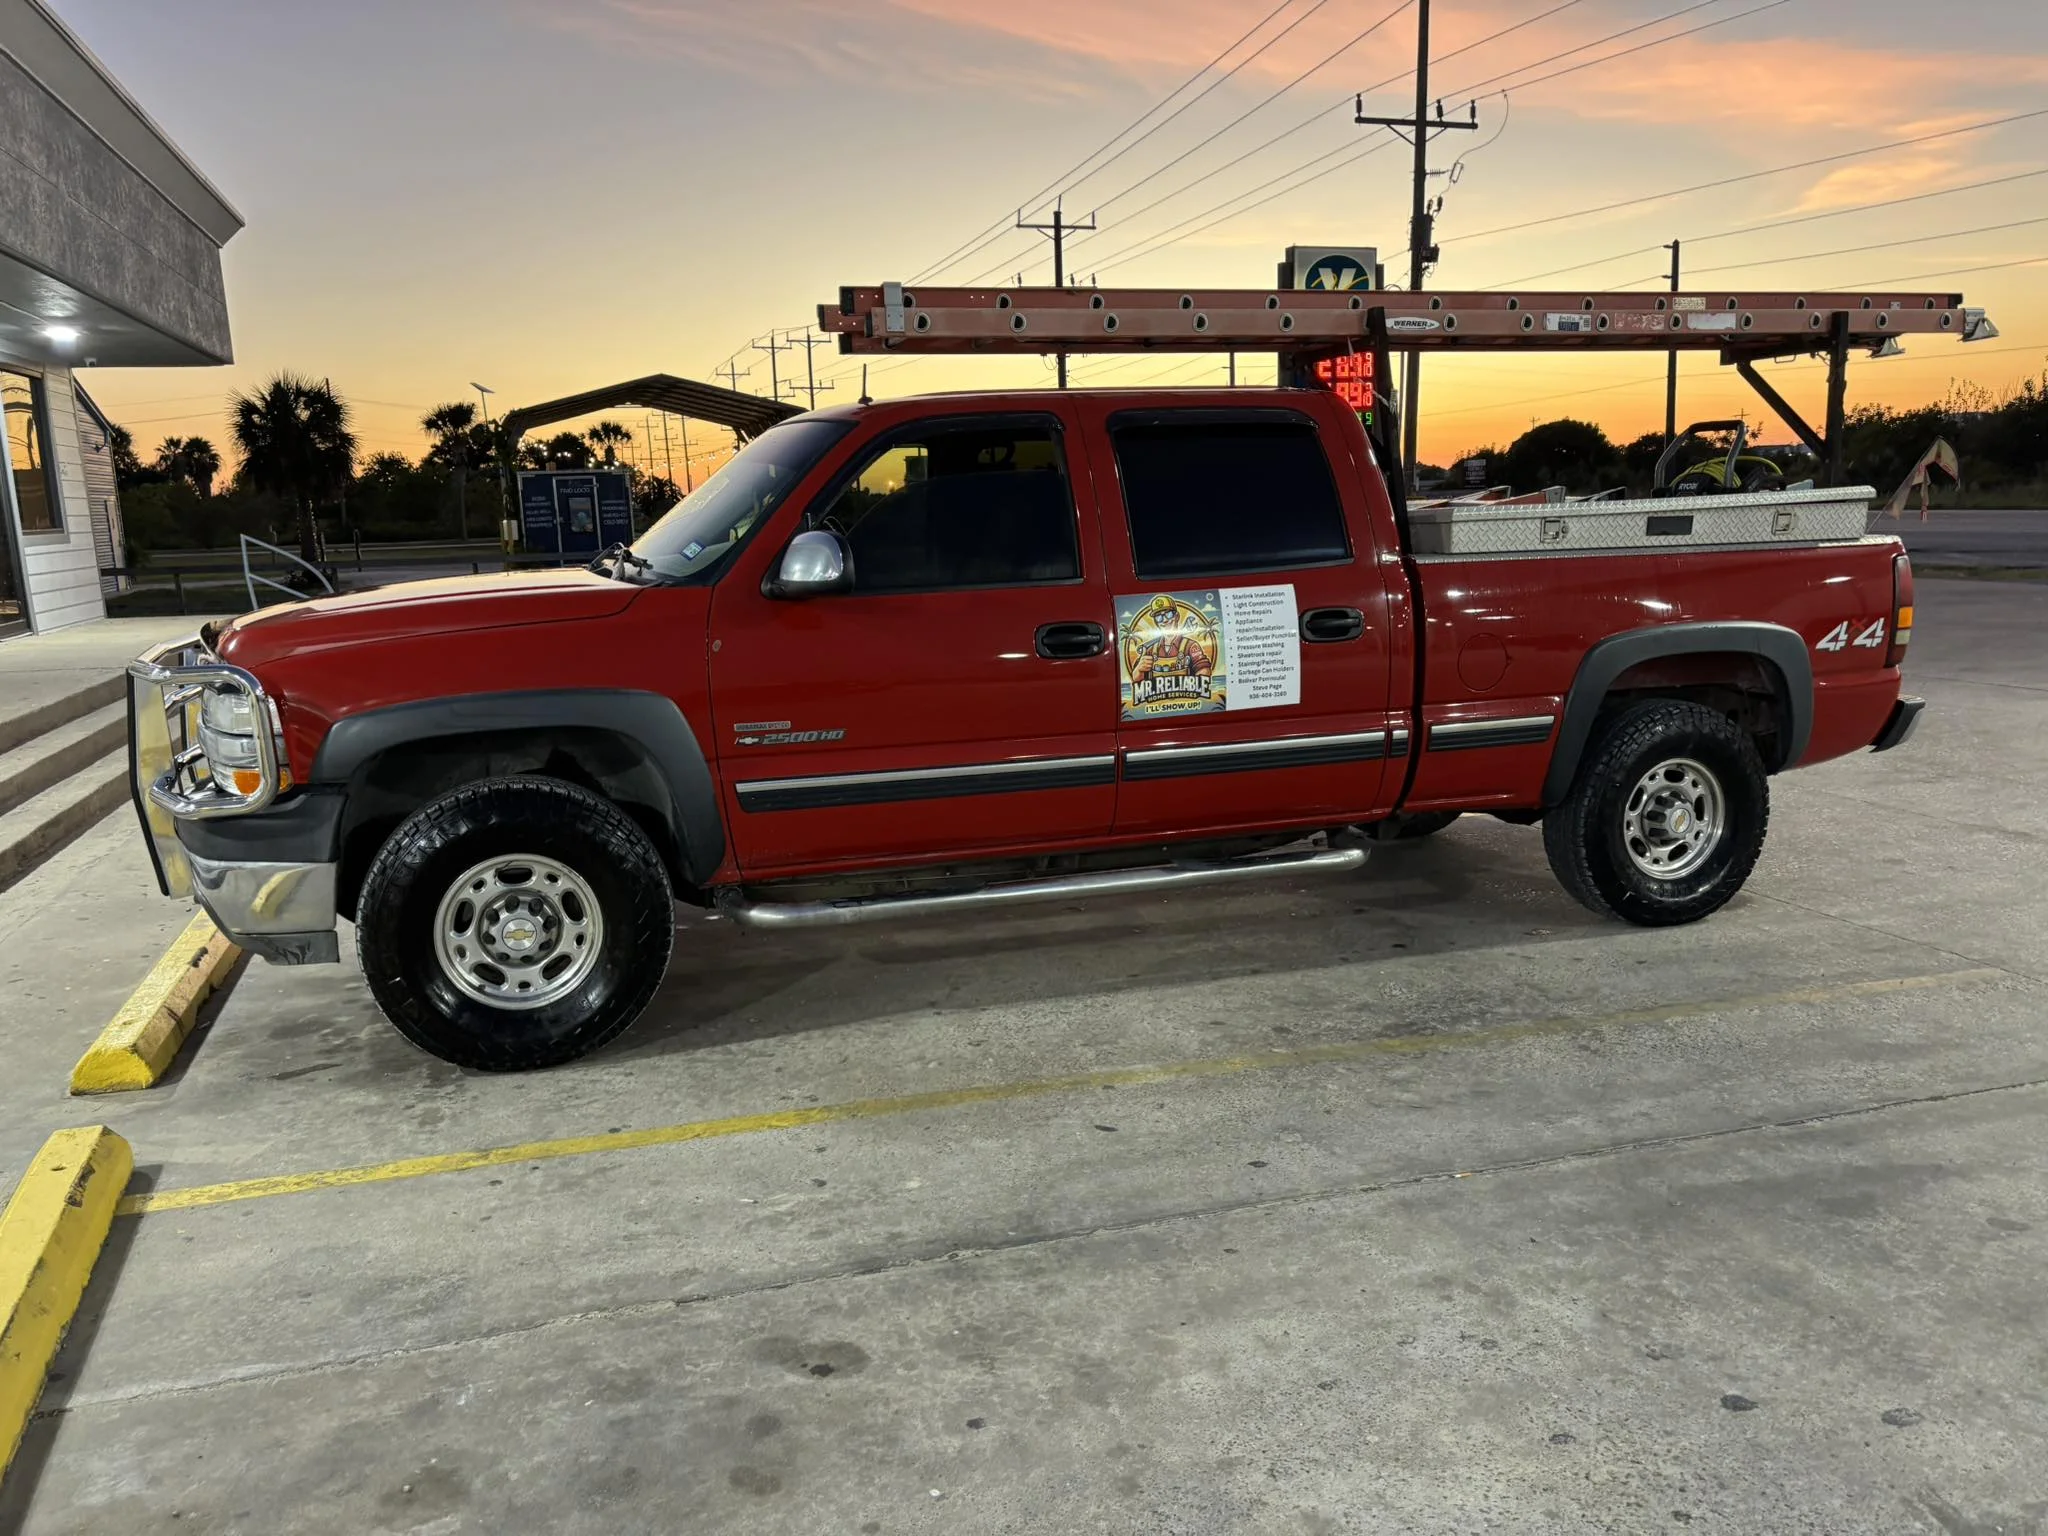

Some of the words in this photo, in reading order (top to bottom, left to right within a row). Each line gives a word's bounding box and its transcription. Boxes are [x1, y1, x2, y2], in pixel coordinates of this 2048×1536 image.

[1248, 599, 1284, 607] Construction
[1252, 608, 1272, 616] Repairs
[1133, 680, 1155, 705] MR.
[1156, 676, 1210, 698] RELIABLE
[1146, 705, 1160, 713] I'LL
[1162, 703, 1185, 711] SHOW
[762, 732, 818, 744] 2500
[820, 730, 845, 741] HD
